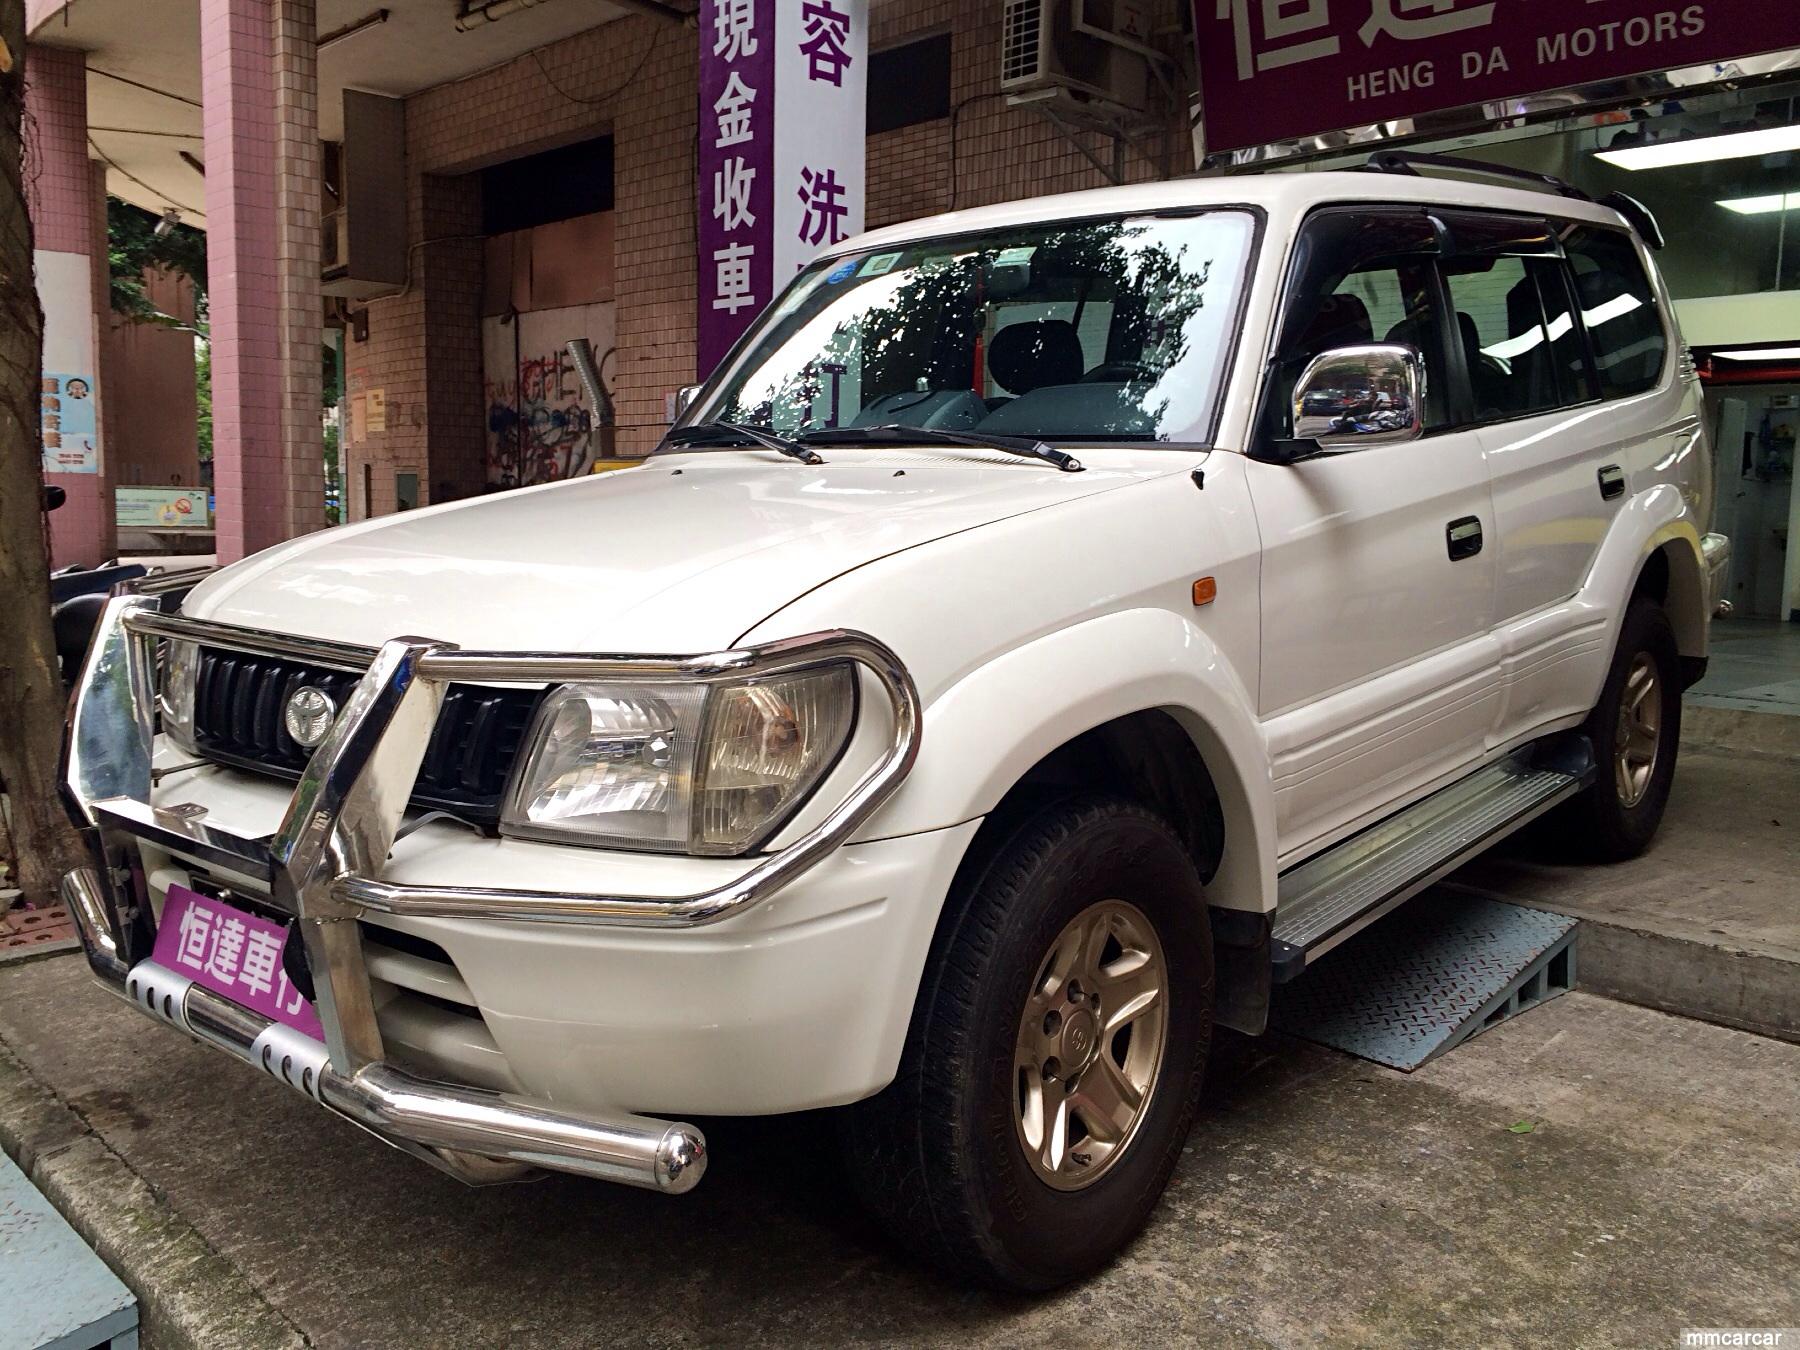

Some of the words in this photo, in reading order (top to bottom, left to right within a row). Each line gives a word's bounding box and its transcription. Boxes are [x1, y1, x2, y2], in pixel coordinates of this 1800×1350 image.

[1347, 60, 1434, 102] HENG
[1462, 46, 1509, 79] DA
[1537, 5, 1705, 65] MOTORS
[712, 0, 758, 315] 現金收車
